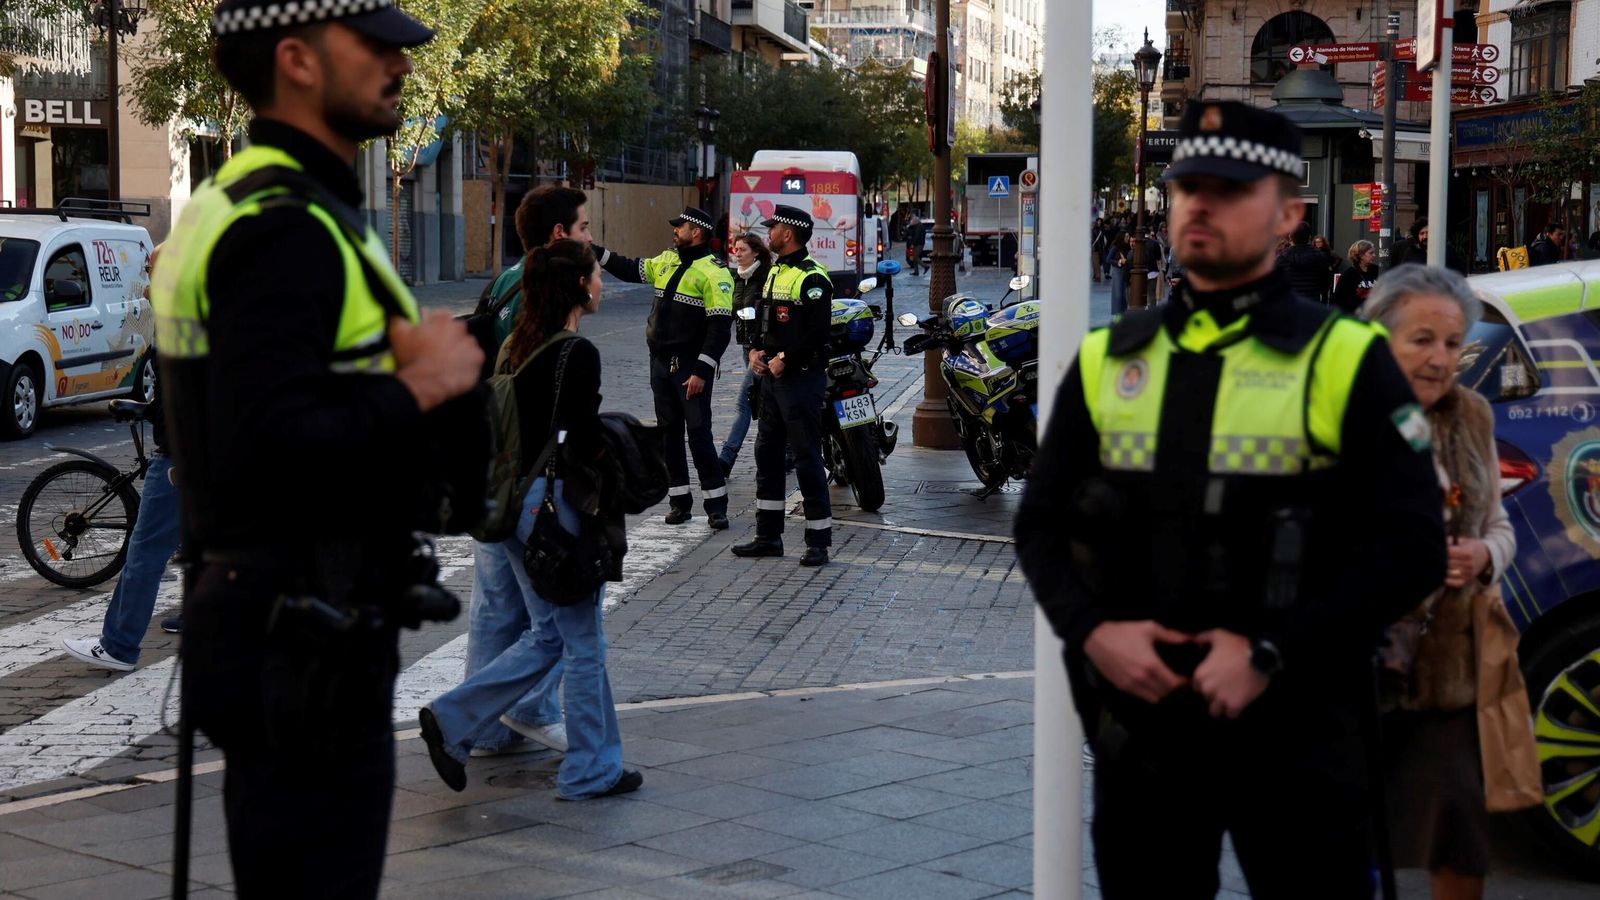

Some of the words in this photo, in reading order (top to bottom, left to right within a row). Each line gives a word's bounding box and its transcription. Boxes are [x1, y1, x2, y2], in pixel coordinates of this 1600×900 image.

[25, 99, 101, 125] BELL
[1146, 138, 1181, 146] ERTICE
[786, 179, 801, 190] 14
[811, 183, 840, 194] 1885
[92, 241, 116, 265] 72h
[98, 266, 122, 282] REUR
[844, 396, 870, 411] 4483
[846, 408, 867, 421] KSN
[1508, 405, 1533, 420] 092
[1545, 406, 1569, 417] 112
